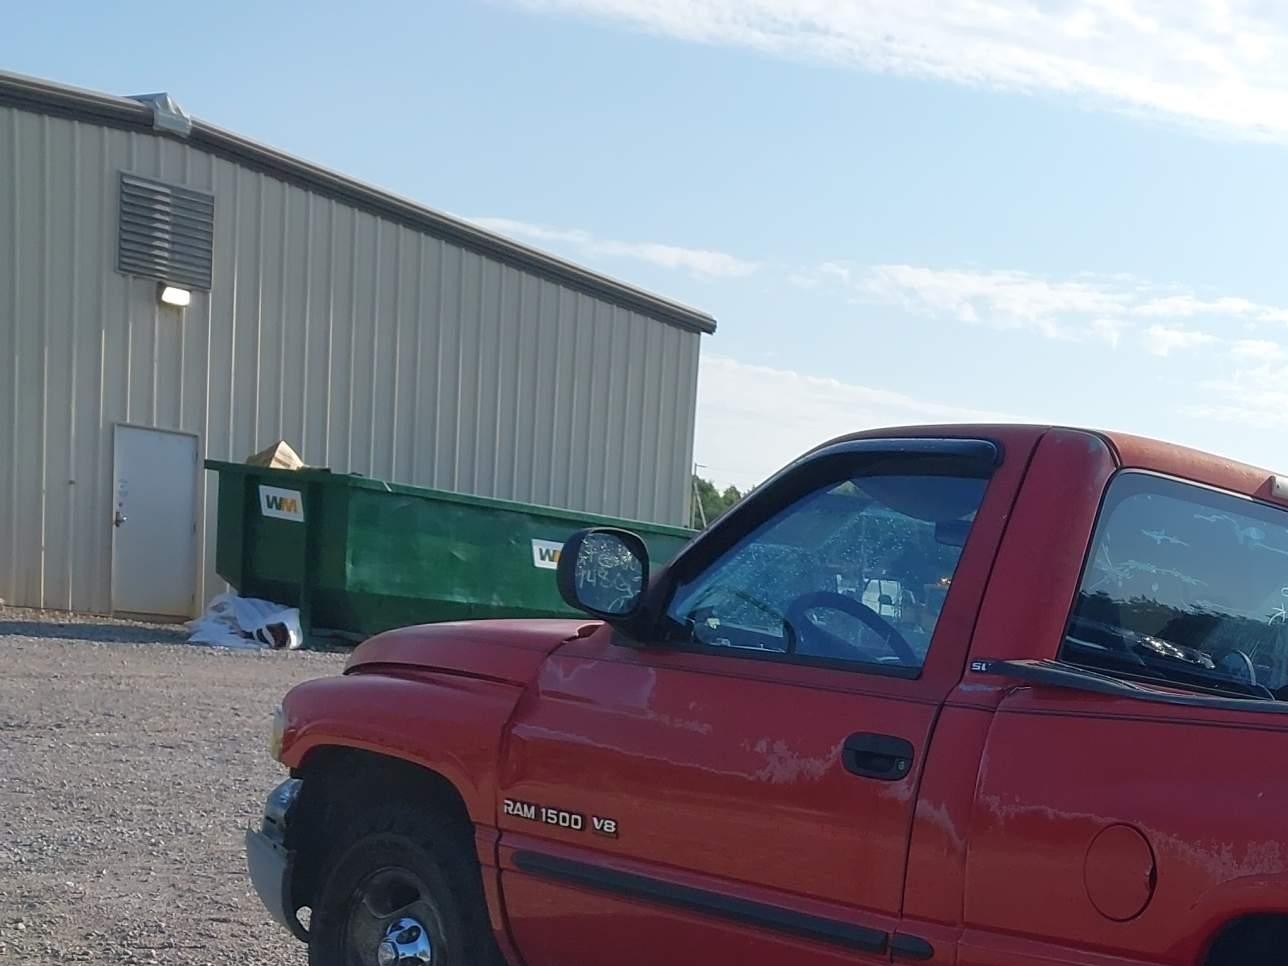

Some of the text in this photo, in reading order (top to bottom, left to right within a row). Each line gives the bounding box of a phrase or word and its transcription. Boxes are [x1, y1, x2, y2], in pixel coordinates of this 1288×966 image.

[265, 494, 298, 513] WM
[503, 799, 617, 833] RAM 1500 V8
